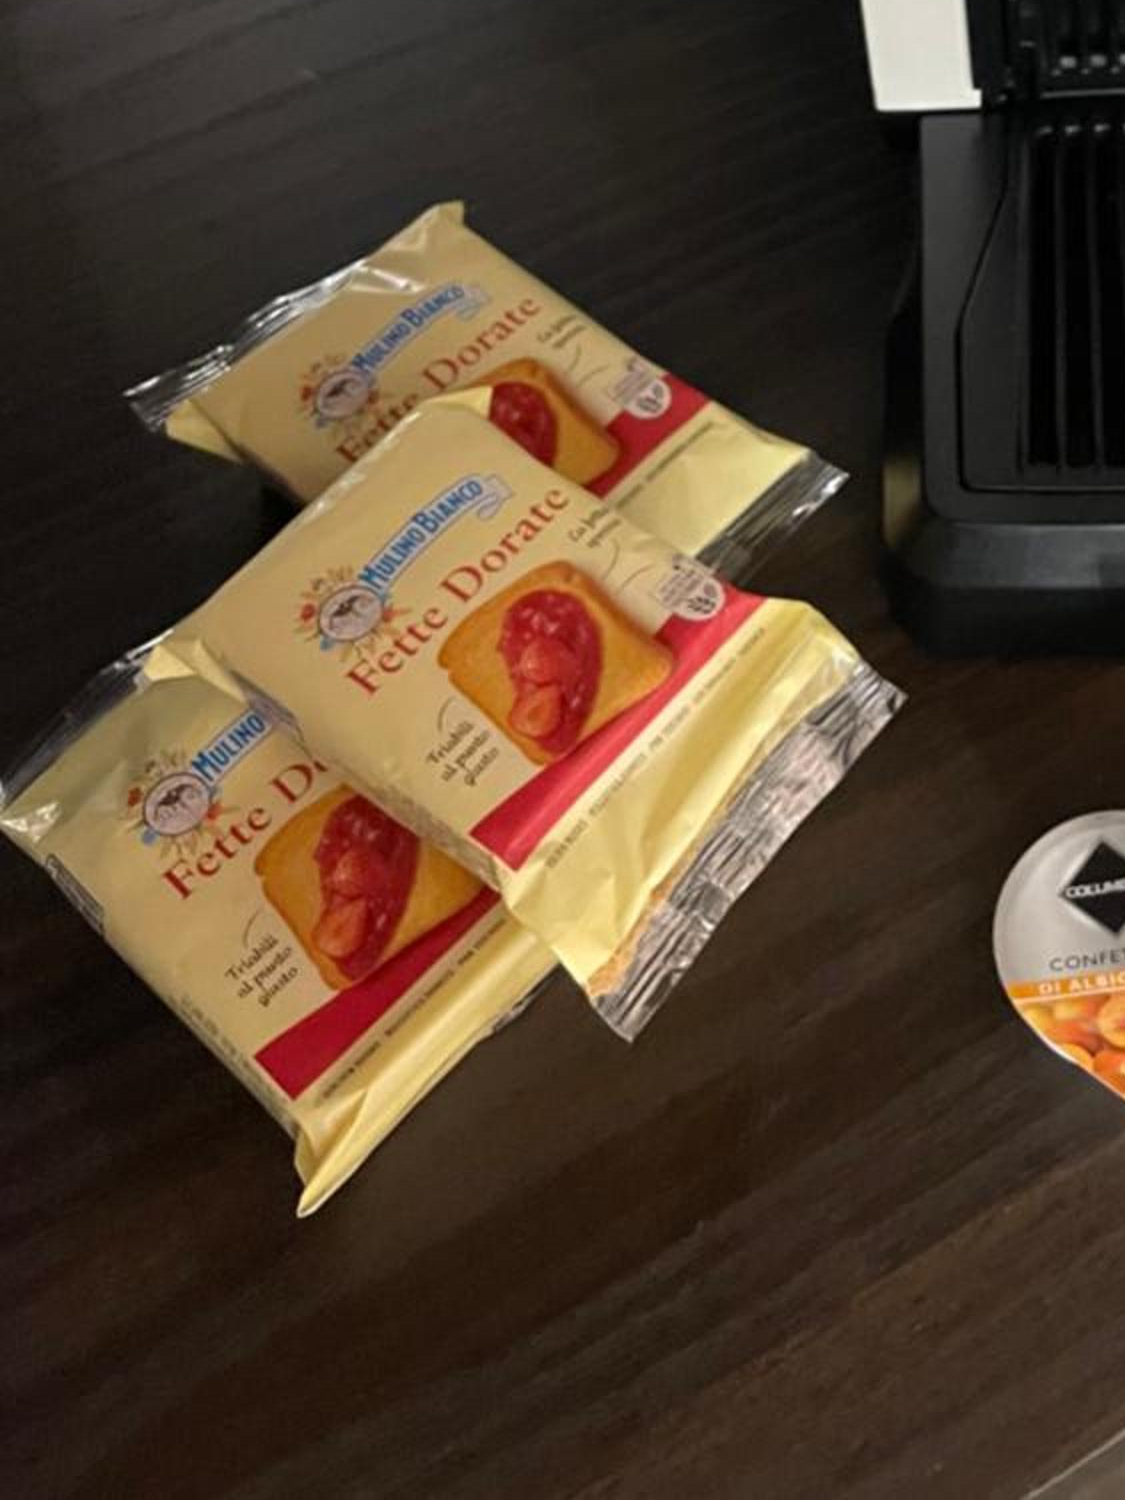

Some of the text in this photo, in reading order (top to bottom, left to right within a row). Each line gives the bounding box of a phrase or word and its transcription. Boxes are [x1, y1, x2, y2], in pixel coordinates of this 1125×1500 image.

[351, 321, 412, 370] MULINO
[421, 298, 541, 391] Dorate
[357, 478, 483, 589] MULINO BIANCO
[346, 607, 449, 695] Fette
[440, 489, 569, 603] Dorate
[192, 712, 268, 782] MULINO
[162, 807, 274, 900] Fette
[237, 980, 254, 999] al
[1039, 982, 1061, 996] DI
